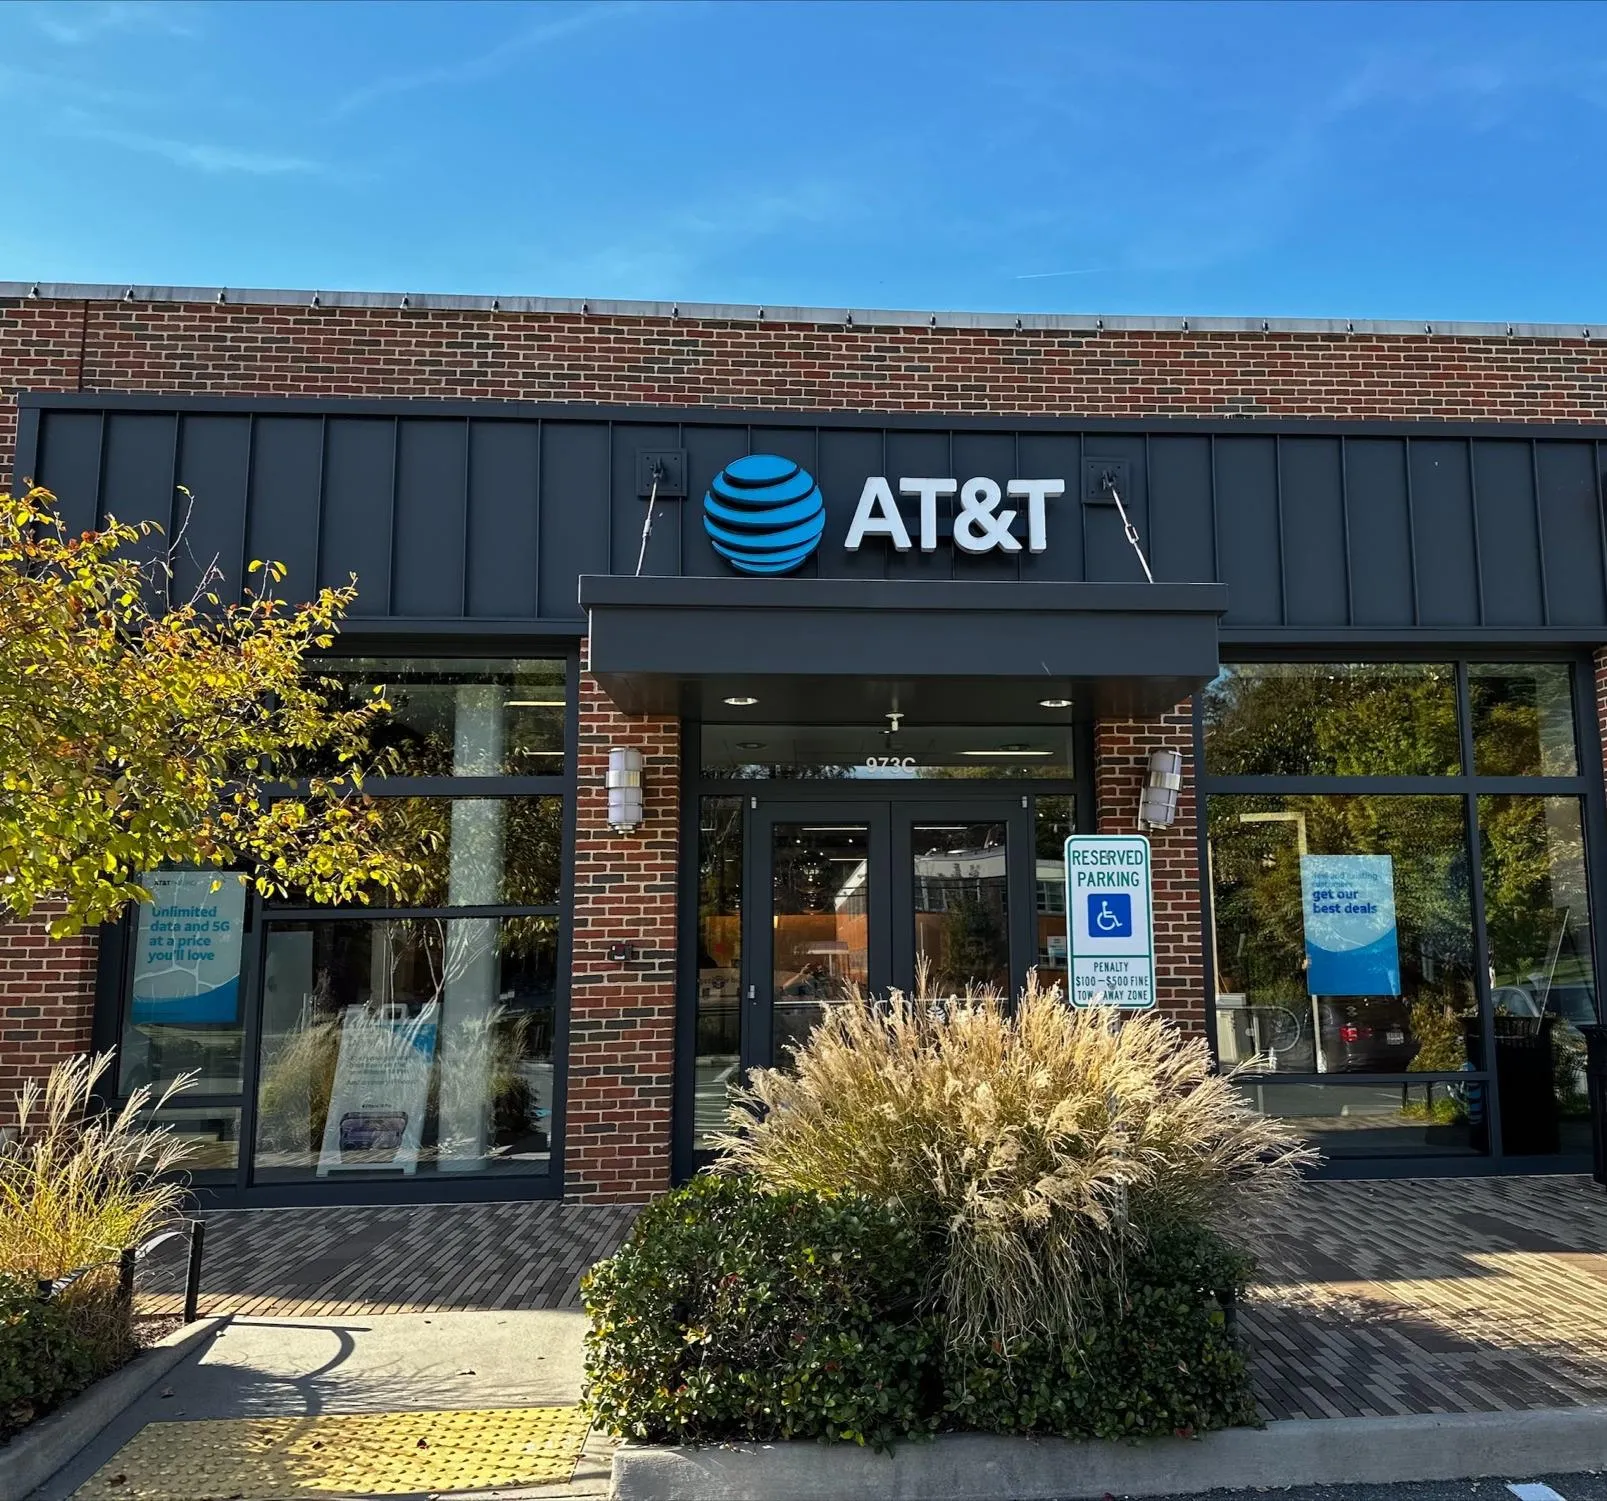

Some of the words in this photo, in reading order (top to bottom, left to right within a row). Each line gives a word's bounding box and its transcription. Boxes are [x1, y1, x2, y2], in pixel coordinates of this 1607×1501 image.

[844, 476, 1065, 554] AT&T
[866, 757, 916, 774] 973C
[1072, 850, 1143, 865] RESERVED
[1078, 872, 1140, 887] PARKING
[1312, 889, 1334, 902] get
[1337, 890, 1359, 900] our
[152, 906, 217, 918] Unlimited
[1313, 902, 1341, 914] best
[1344, 902, 1378, 914] deals
[150, 921, 181, 932] data
[184, 921, 209, 932] and
[212, 921, 230, 932] 5G
[149, 936, 163, 946] at
[166, 937, 175, 946] a
[178, 935, 211, 949] price
[148, 950, 184, 963] you'll
[187, 950, 215, 961] love
[1093, 962, 1129, 972] PENALTY
[1130, 976, 1149, 986] FINE
[1103, 990, 1124, 1000] AWAY
[1127, 990, 1148, 1000] ZONE
